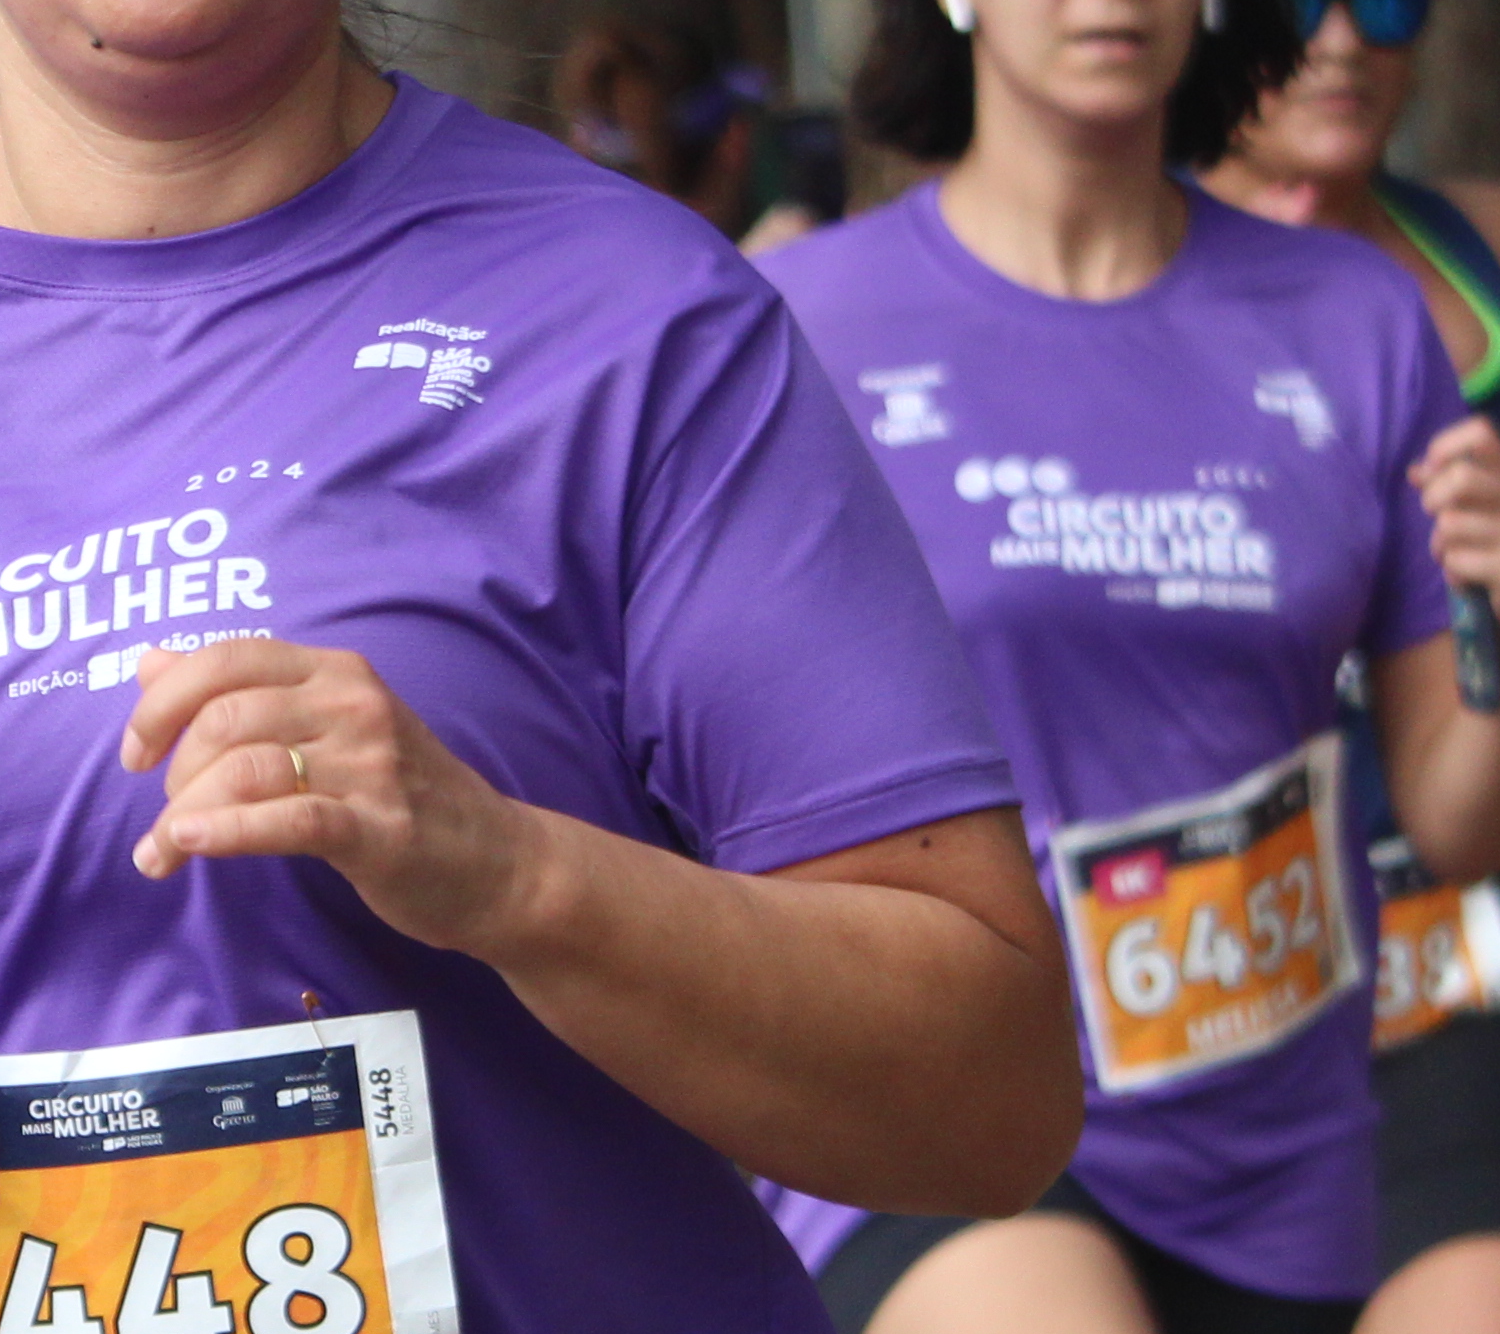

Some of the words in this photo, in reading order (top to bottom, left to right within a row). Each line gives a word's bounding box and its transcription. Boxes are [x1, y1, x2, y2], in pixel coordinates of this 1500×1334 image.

[378, 318, 488, 342] Realização:
[184, 460, 304, 493] 2024
[1008, 495, 1245, 539] CIRCUITO
[1060, 534, 1276, 579] MULHER
[8, 671, 85, 698] EDIÇÃO:
[1105, 858, 1318, 1017] 6452
[29, 1090, 143, 1120] CIRCUITO
[368, 1068, 398, 1138] 5448
[395, 1065, 415, 1135] MEDALHA
[21, 1122, 53, 1136] MAIS
[54, 1108, 161, 1139] MULHER
